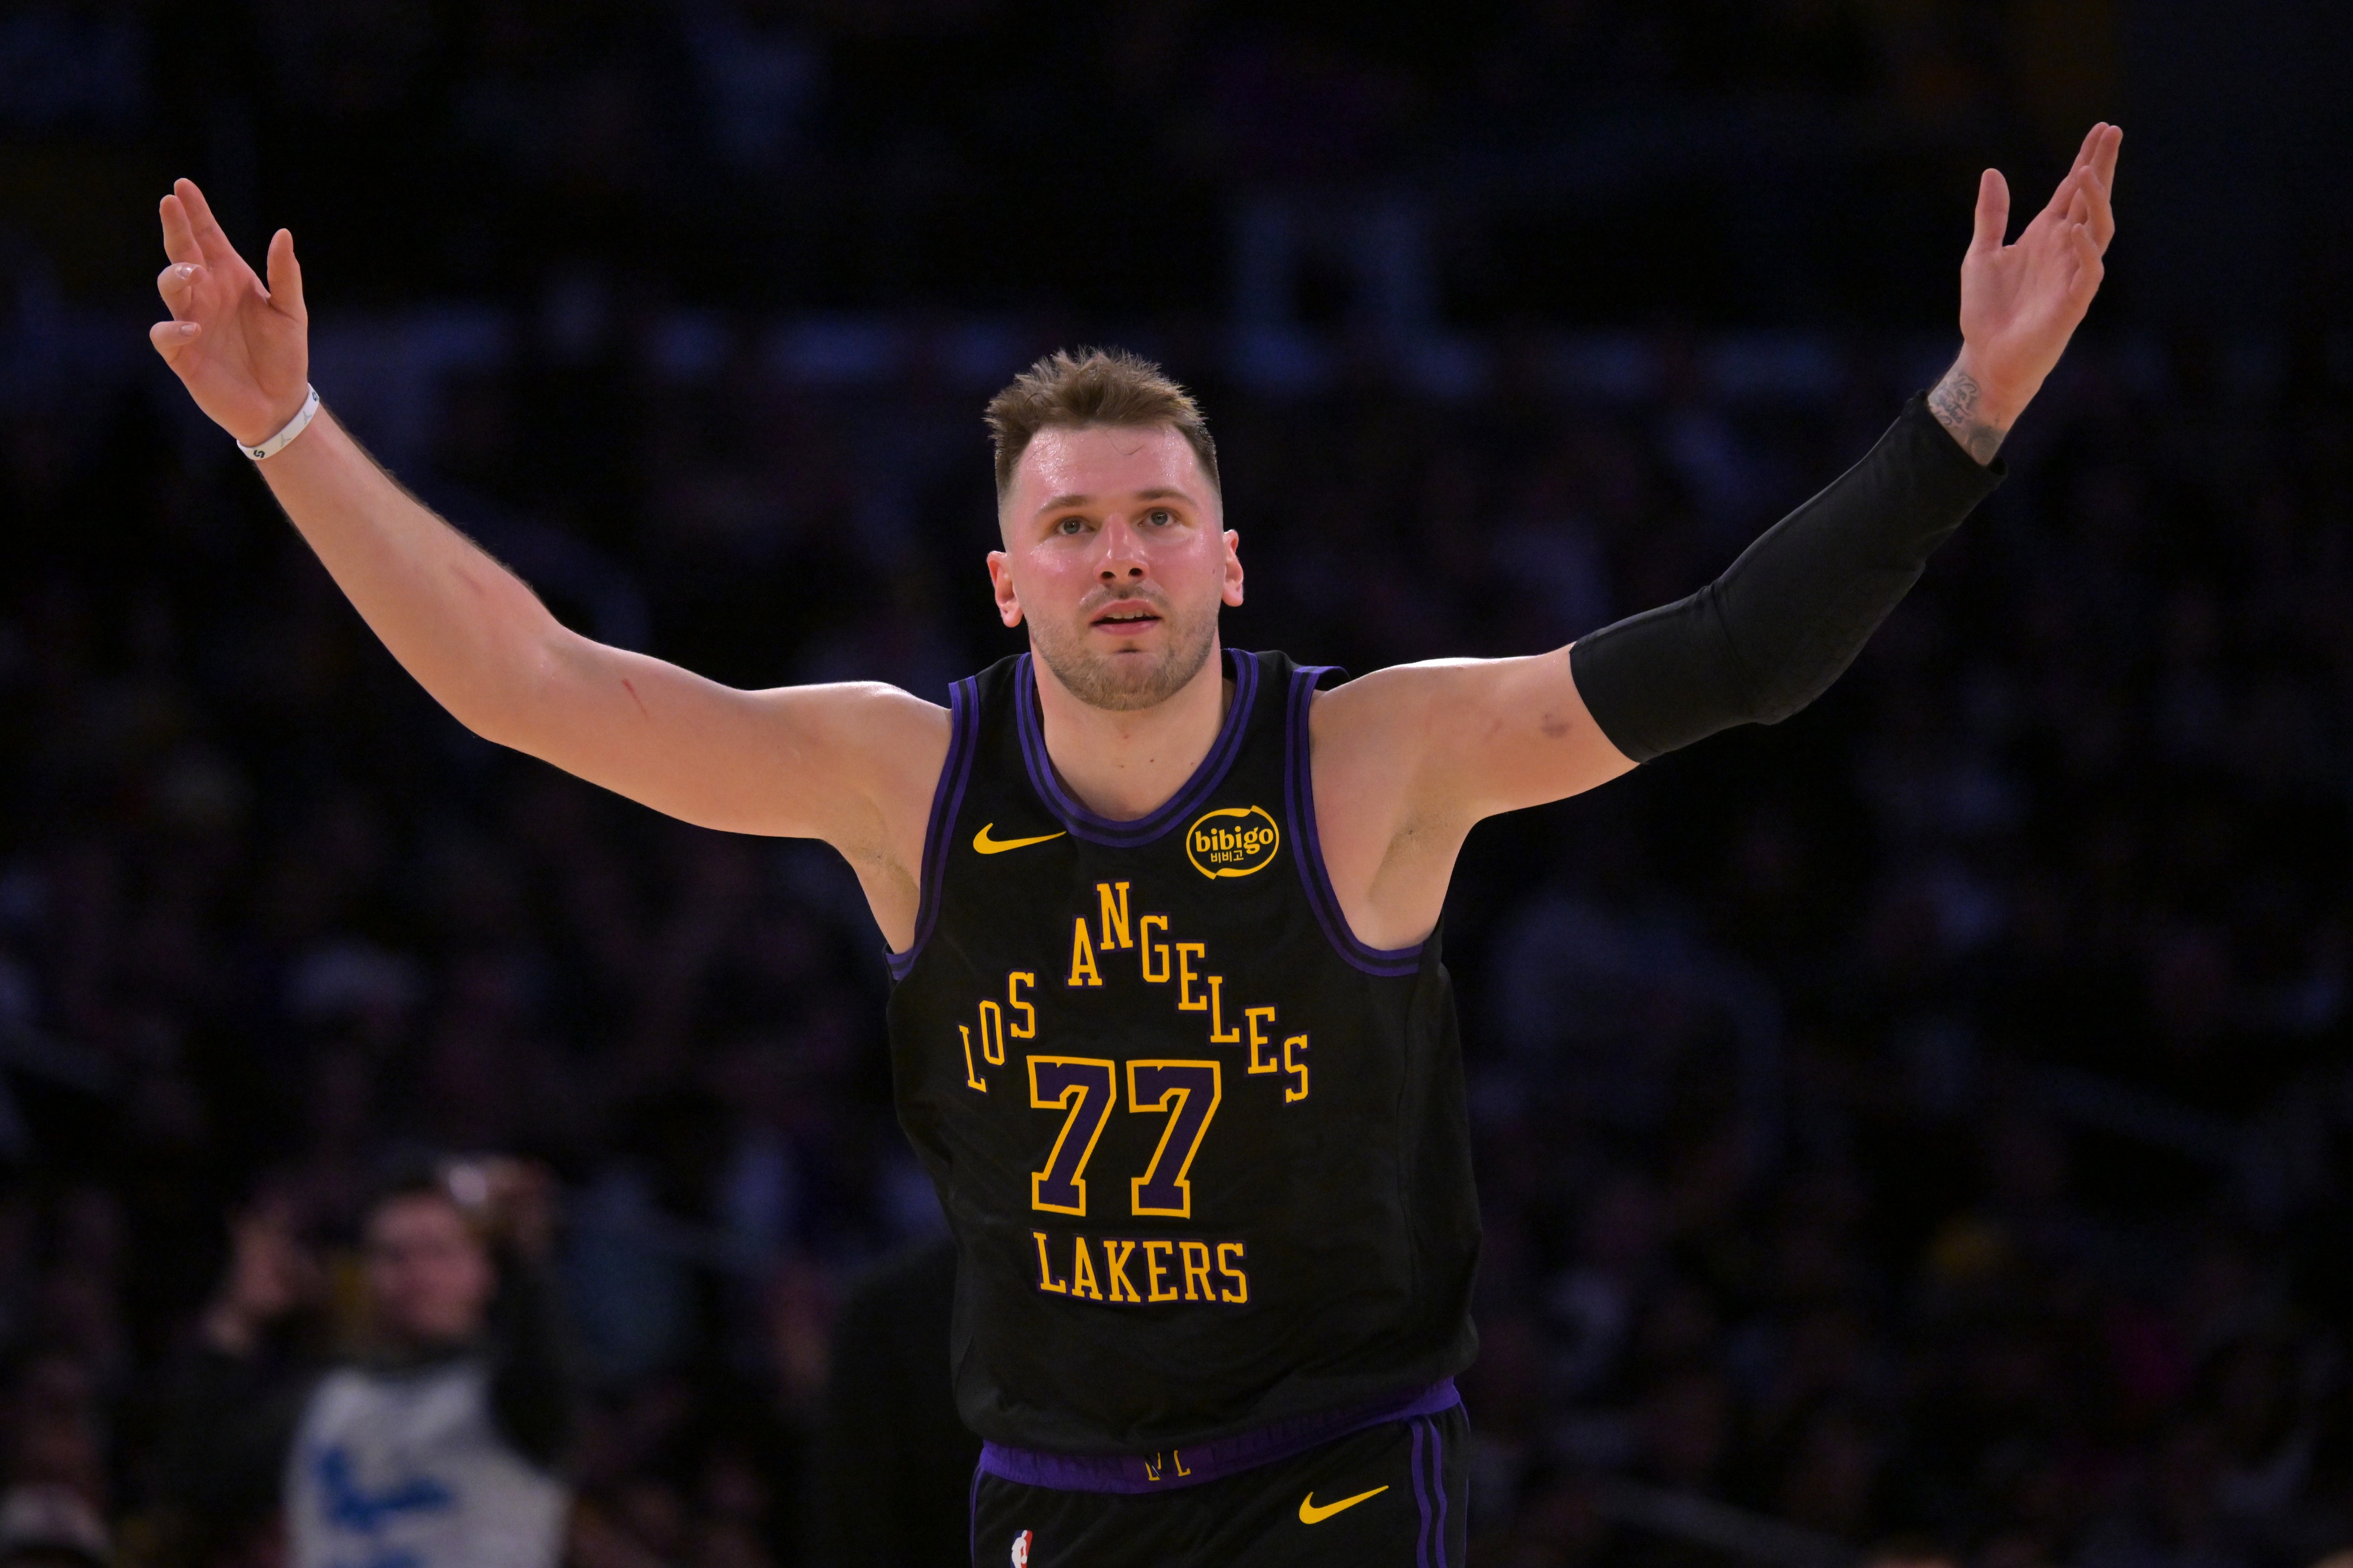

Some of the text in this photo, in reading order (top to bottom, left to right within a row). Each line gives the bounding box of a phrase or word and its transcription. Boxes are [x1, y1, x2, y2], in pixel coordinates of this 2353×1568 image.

[1195, 826, 1274, 855] bibigo
[1210, 850, 1244, 864] 비비고
[958, 881, 1309, 1104] LOS ANGELES
[1026, 1055, 1222, 1220] 77
[1032, 1230, 1249, 1305] LAKERS
